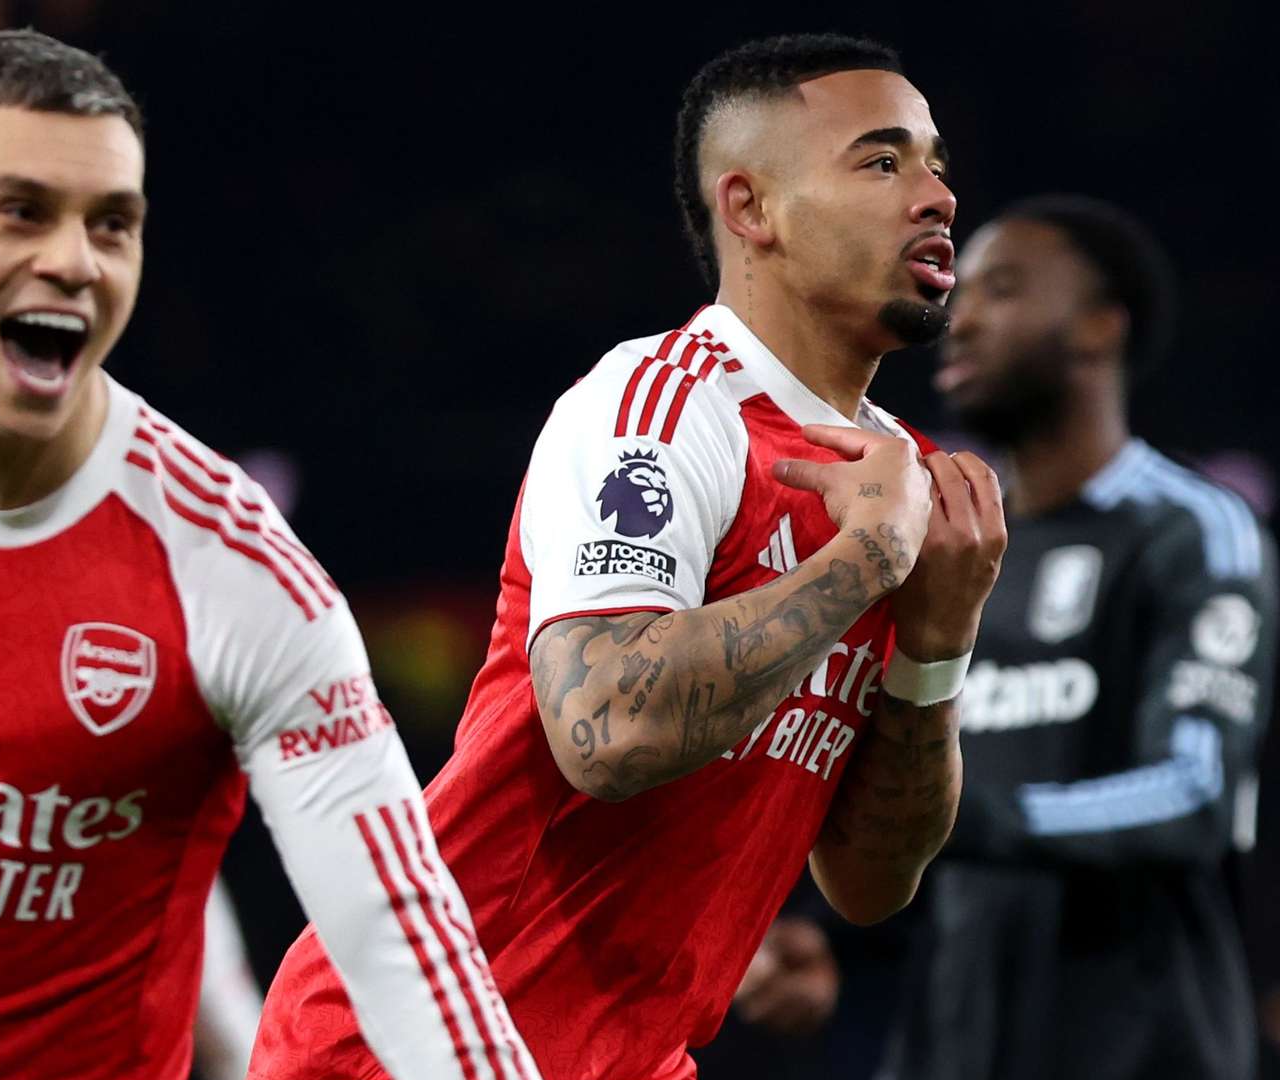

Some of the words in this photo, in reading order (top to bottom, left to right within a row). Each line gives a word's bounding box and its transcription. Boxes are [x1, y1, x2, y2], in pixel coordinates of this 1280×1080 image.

[578, 542, 608, 561] No
[610, 543, 667, 570] room
[575, 560, 607, 575] for
[607, 559, 675, 587] racism
[571, 699, 612, 760] 97
